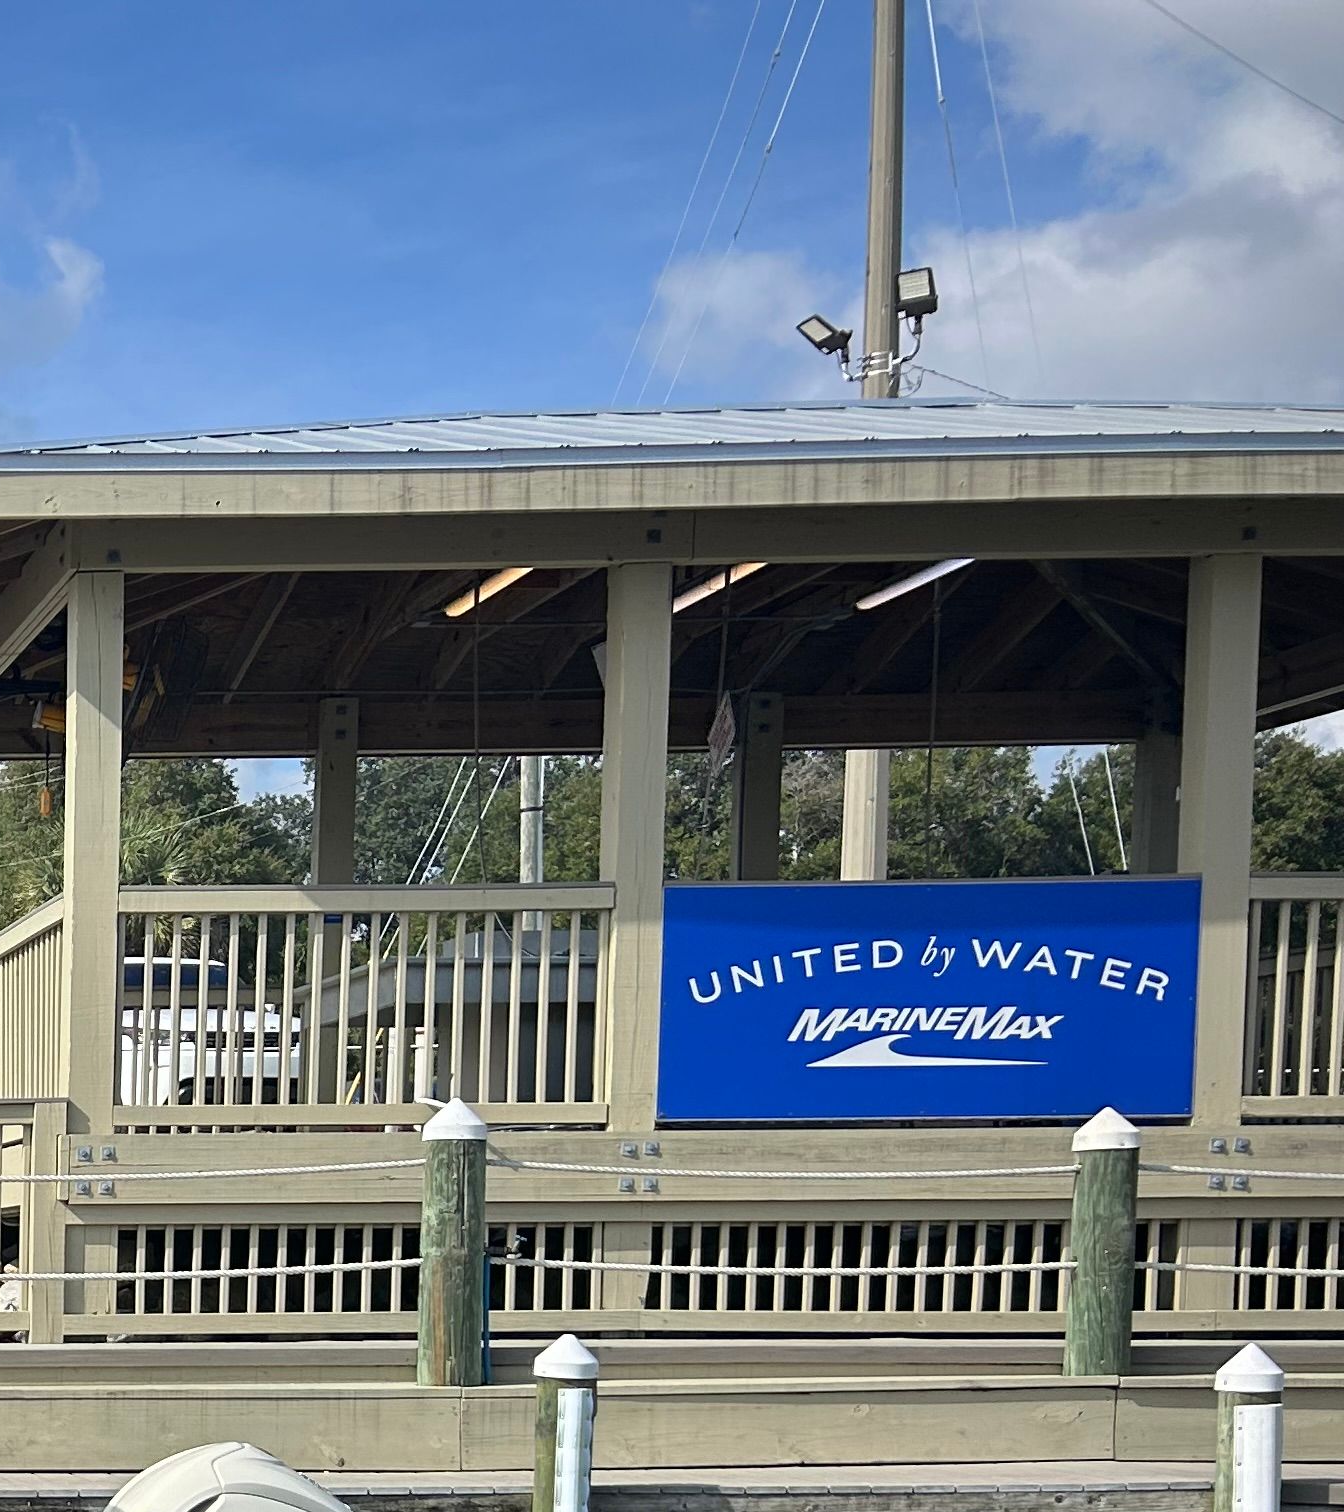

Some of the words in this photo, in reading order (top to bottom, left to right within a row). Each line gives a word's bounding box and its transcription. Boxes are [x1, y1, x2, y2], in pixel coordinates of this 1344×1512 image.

[688, 939, 903, 1004] UNITED
[920, 936, 956, 978] by
[972, 938, 1170, 1001] WATER
